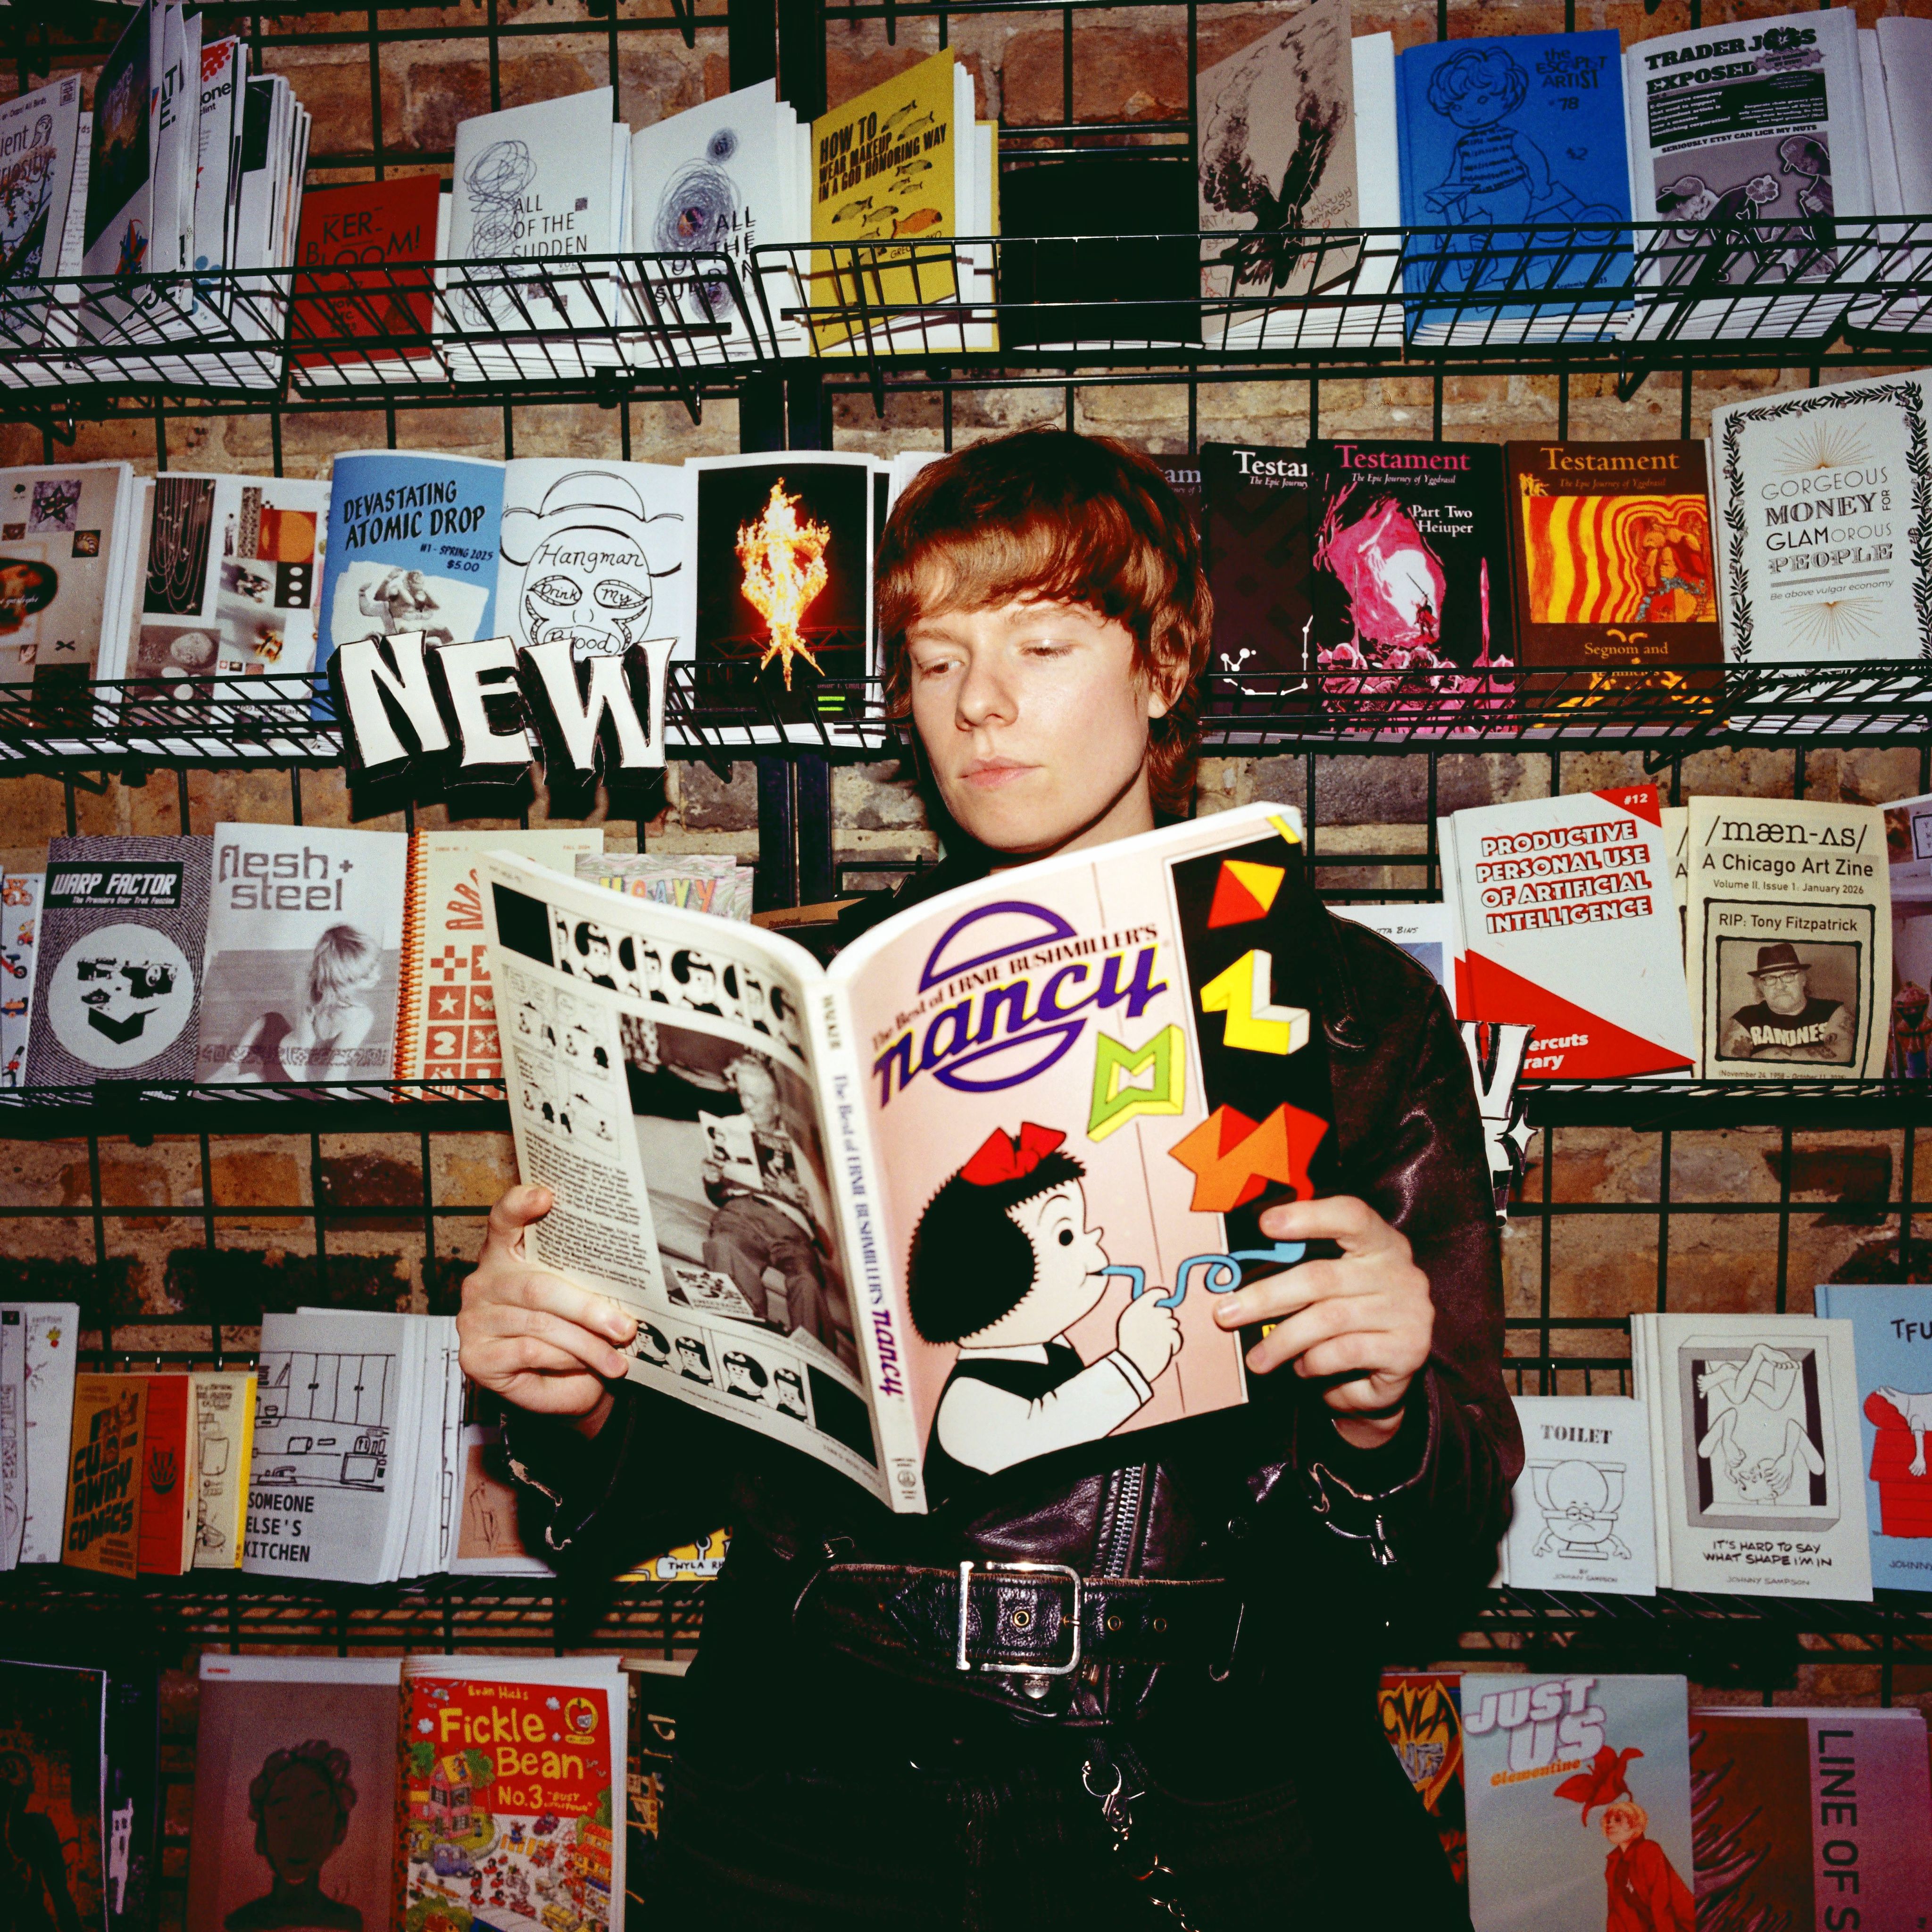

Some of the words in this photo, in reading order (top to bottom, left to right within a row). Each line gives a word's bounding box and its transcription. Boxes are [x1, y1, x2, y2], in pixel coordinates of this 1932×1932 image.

[1544, 49, 1571, 60] the
[1645, 39, 1746, 70] TRADER
[1542, 70, 1598, 89] ARTIST
[1647, 61, 1758, 94] EXPOSED
[820, 124, 853, 164] HOW
[858, 111, 877, 145] TO
[1662, 139, 1707, 153] SERIOUSLY
[1710, 135, 1732, 143] ETSY
[819, 155, 846, 183] WEAR
[850, 132, 891, 168] MAKEUP
[819, 182, 829, 203] IN
[832, 177, 838, 196] A
[841, 165, 861, 191] GOD
[865, 137, 919, 179] HONORING
[924, 123, 946, 151] WAY
[514, 194, 542, 215] ALL
[323, 211, 383, 245] KER-
[514, 219, 535, 239] OF
[542, 212, 574, 233] THE
[716, 207, 756, 233] ALL
[512, 234, 586, 258] SUDDEN
[1232, 450, 1308, 477] Testa
[1333, 444, 1471, 470] Testament
[1540, 447, 1680, 471] Testament
[1250, 476, 1262, 485] The
[1265, 476, 1279, 488] Epic
[1282, 478, 1308, 490] Journey
[1352, 473, 1365, 482] The
[1367, 474, 1382, 484] Epic
[1384, 474, 1412, 485] Journey
[1414, 475, 1422, 485] of
[1560, 478, 1573, 487] The
[1576, 479, 1590, 489] Epic
[1592, 478, 1619, 490] Journey
[1623, 479, 1631, 488] of
[1761, 466, 1887, 500] GORGEOUS
[343, 480, 457, 524] DEVASTATING
[1413, 505, 1440, 517] Part
[1444, 506, 1473, 518] Two
[1765, 492, 1877, 526] MONEY
[1881, 490, 1891, 511] FOR
[345, 512, 421, 550] ATOMIC
[431, 505, 485, 541] DROP
[1418, 520, 1474, 537] Heiuper
[1766, 523, 1891, 551] GLAMOROUS
[440, 545, 468, 558] SPRING
[472, 550, 493, 561] 2025
[447, 559, 480, 572] $5.00
[538, 543, 644, 573] Hangman
[1768, 543, 1893, 574] PEOPLE
[541, 581, 580, 602] Drink
[600, 587, 633, 605] My
[1785, 589, 1814, 599] above
[1816, 585, 1847, 595] vulgar
[1849, 580, 1894, 591] economy
[1584, 642, 1639, 659] Segnom
[1643, 641, 1669, 654] and
[337, 630, 679, 778] NEW
[1624, 793, 1648, 805] #12
[1481, 820, 1638, 857] PRODUCTIVE
[218, 844, 329, 882] flesh
[1476, 850, 1602, 883] PERSONAL
[1603, 844, 1650, 868] USE
[1702, 853, 1715, 869] A
[1723, 854, 1796, 876] Chicago
[1802, 857, 1830, 874] Art
[1836, 858, 1874, 876] Zine
[50, 873, 103, 895] WARP
[105, 873, 177, 895] FACTOR
[230, 878, 343, 911] steel
[1481, 886, 1516, 908] OF
[1518, 870, 1652, 905] ARTIFICIAL
[1714, 879, 1749, 889] Volume
[1763, 881, 1788, 891] Issue
[1802, 884, 1840, 896] January
[1843, 885, 1864, 894] 2026
[1486, 895, 1653, 933] INTELLIGENCE
[1719, 913, 1747, 927] RIP:
[1750, 915, 1782, 930] Tony
[1786, 916, 1857, 932] Fitzpatrick
[896, 1001, 926, 1026] Best
[928, 991, 944, 1009] of
[948, 968, 1000, 998] ERNIE
[1008, 923, 1158, 975] BUSHMILLER'S
[872, 942, 1168, 1109] nancy
[1528, 1033, 1589, 1051] ercuts
[1523, 1054, 1565, 1071] rary
[846, 1156, 866, 1196] ERNIE
[872, 1308, 904, 1397] nancy
[1541, 1424, 1612, 1444] TOILET
[73, 1457, 133, 1518] AWAY
[248, 1492, 314, 1512] SOMEONE
[246, 1516, 301, 1536] ELSE'S
[243, 1540, 310, 1562] KITCHEN
[1703, 1552, 1741, 1562] WHAT
[1746, 1554, 1791, 1566] SHAPE
[1794, 1557, 1814, 1566] I'M
[1817, 1558, 1832, 1567] IN
[1713, 1540, 1736, 1549] IT'S
[1740, 1541, 1774, 1551] HARD
[1777, 1541, 1792, 1551] TO
[1796, 1543, 1820, 1554] SAY
[668, 1562, 704, 1570] TWYLA
[1462, 1677, 1598, 1736] JUST
[439, 1705, 547, 1743] Fickle
[1507, 1704, 1607, 1773] US
[497, 1746, 584, 1780] Bean
[1818, 1730, 1858, 1827] LINE
[1823, 1840, 1860, 1895] OF
